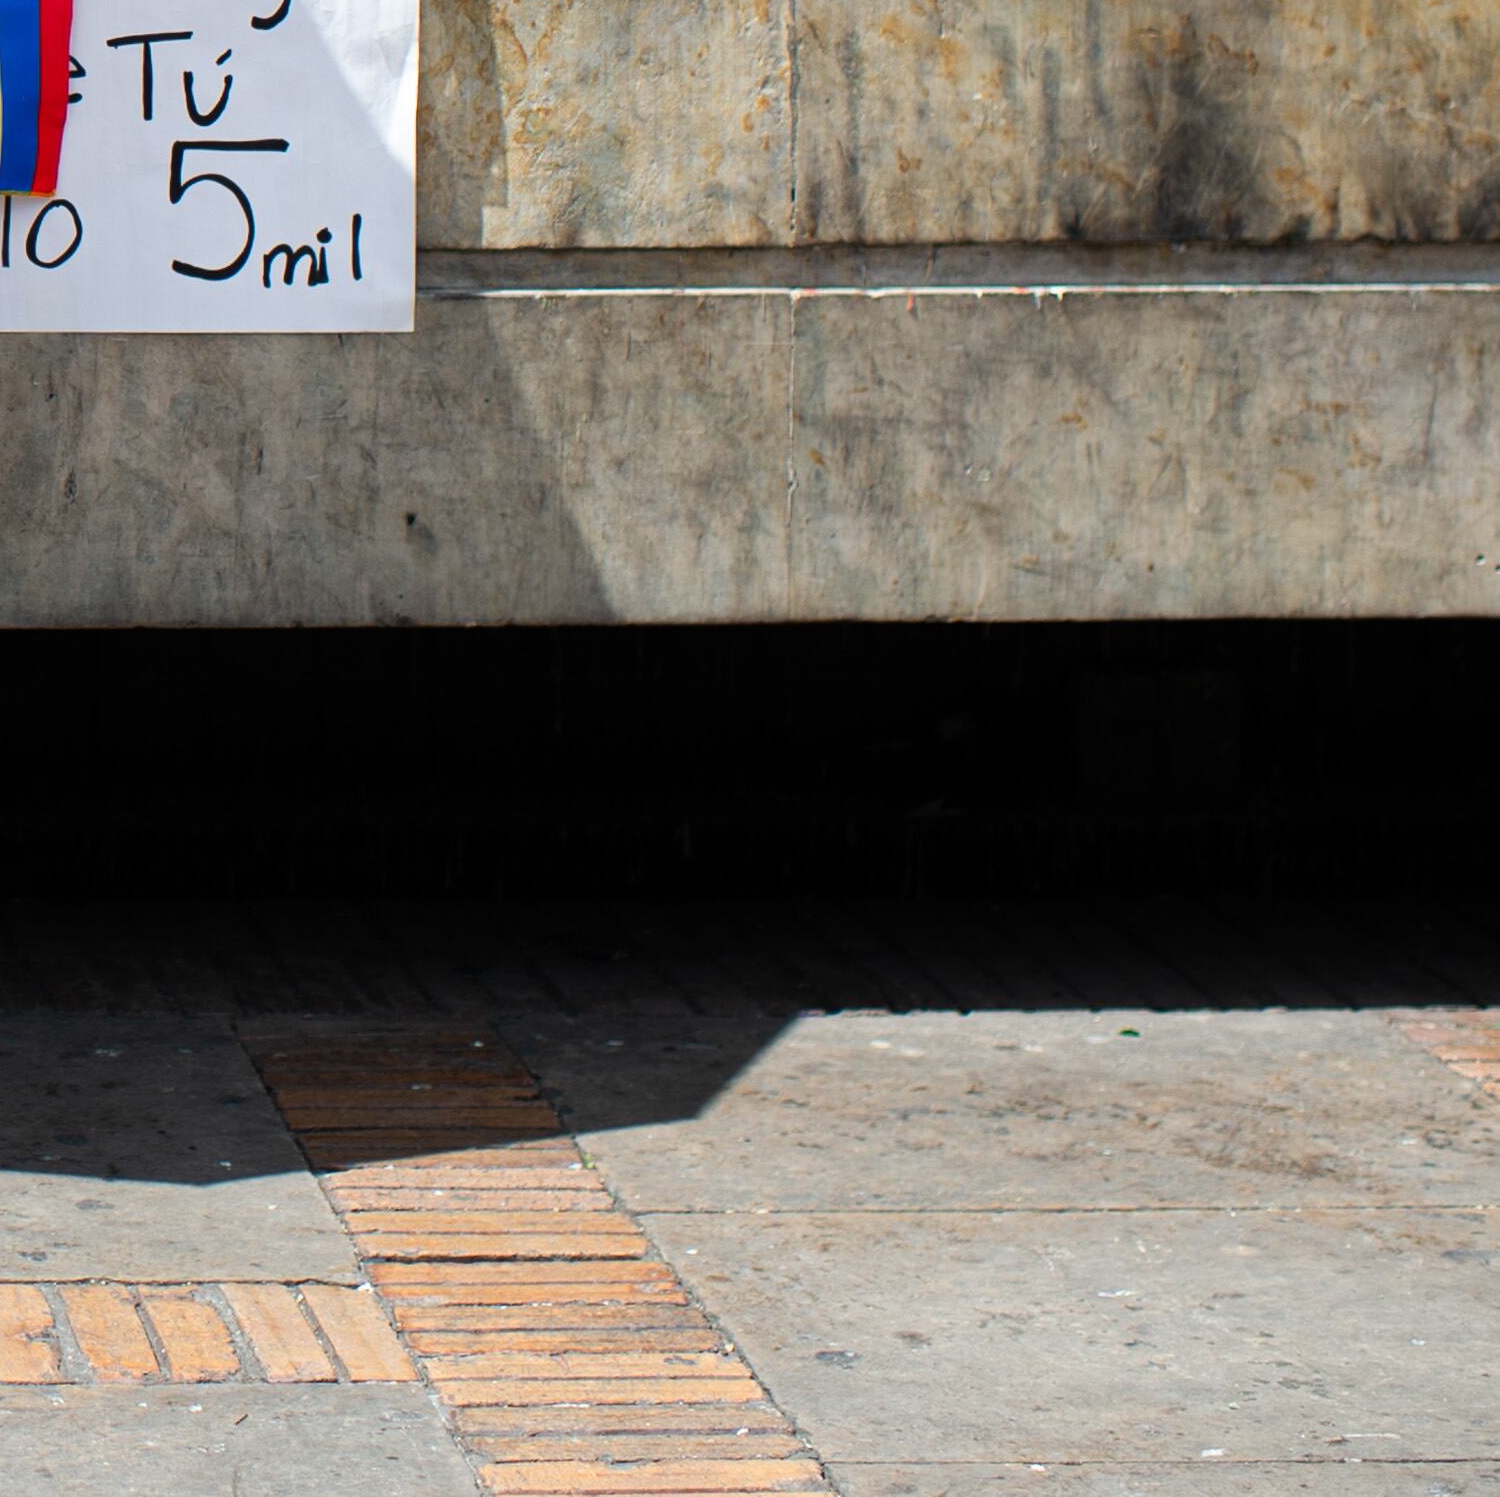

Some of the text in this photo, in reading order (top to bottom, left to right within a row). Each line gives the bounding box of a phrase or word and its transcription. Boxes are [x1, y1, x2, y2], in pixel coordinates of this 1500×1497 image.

[106, 30, 233, 127] Tú
[168, 138, 291, 282] 5
[261, 212, 363, 289] mil
